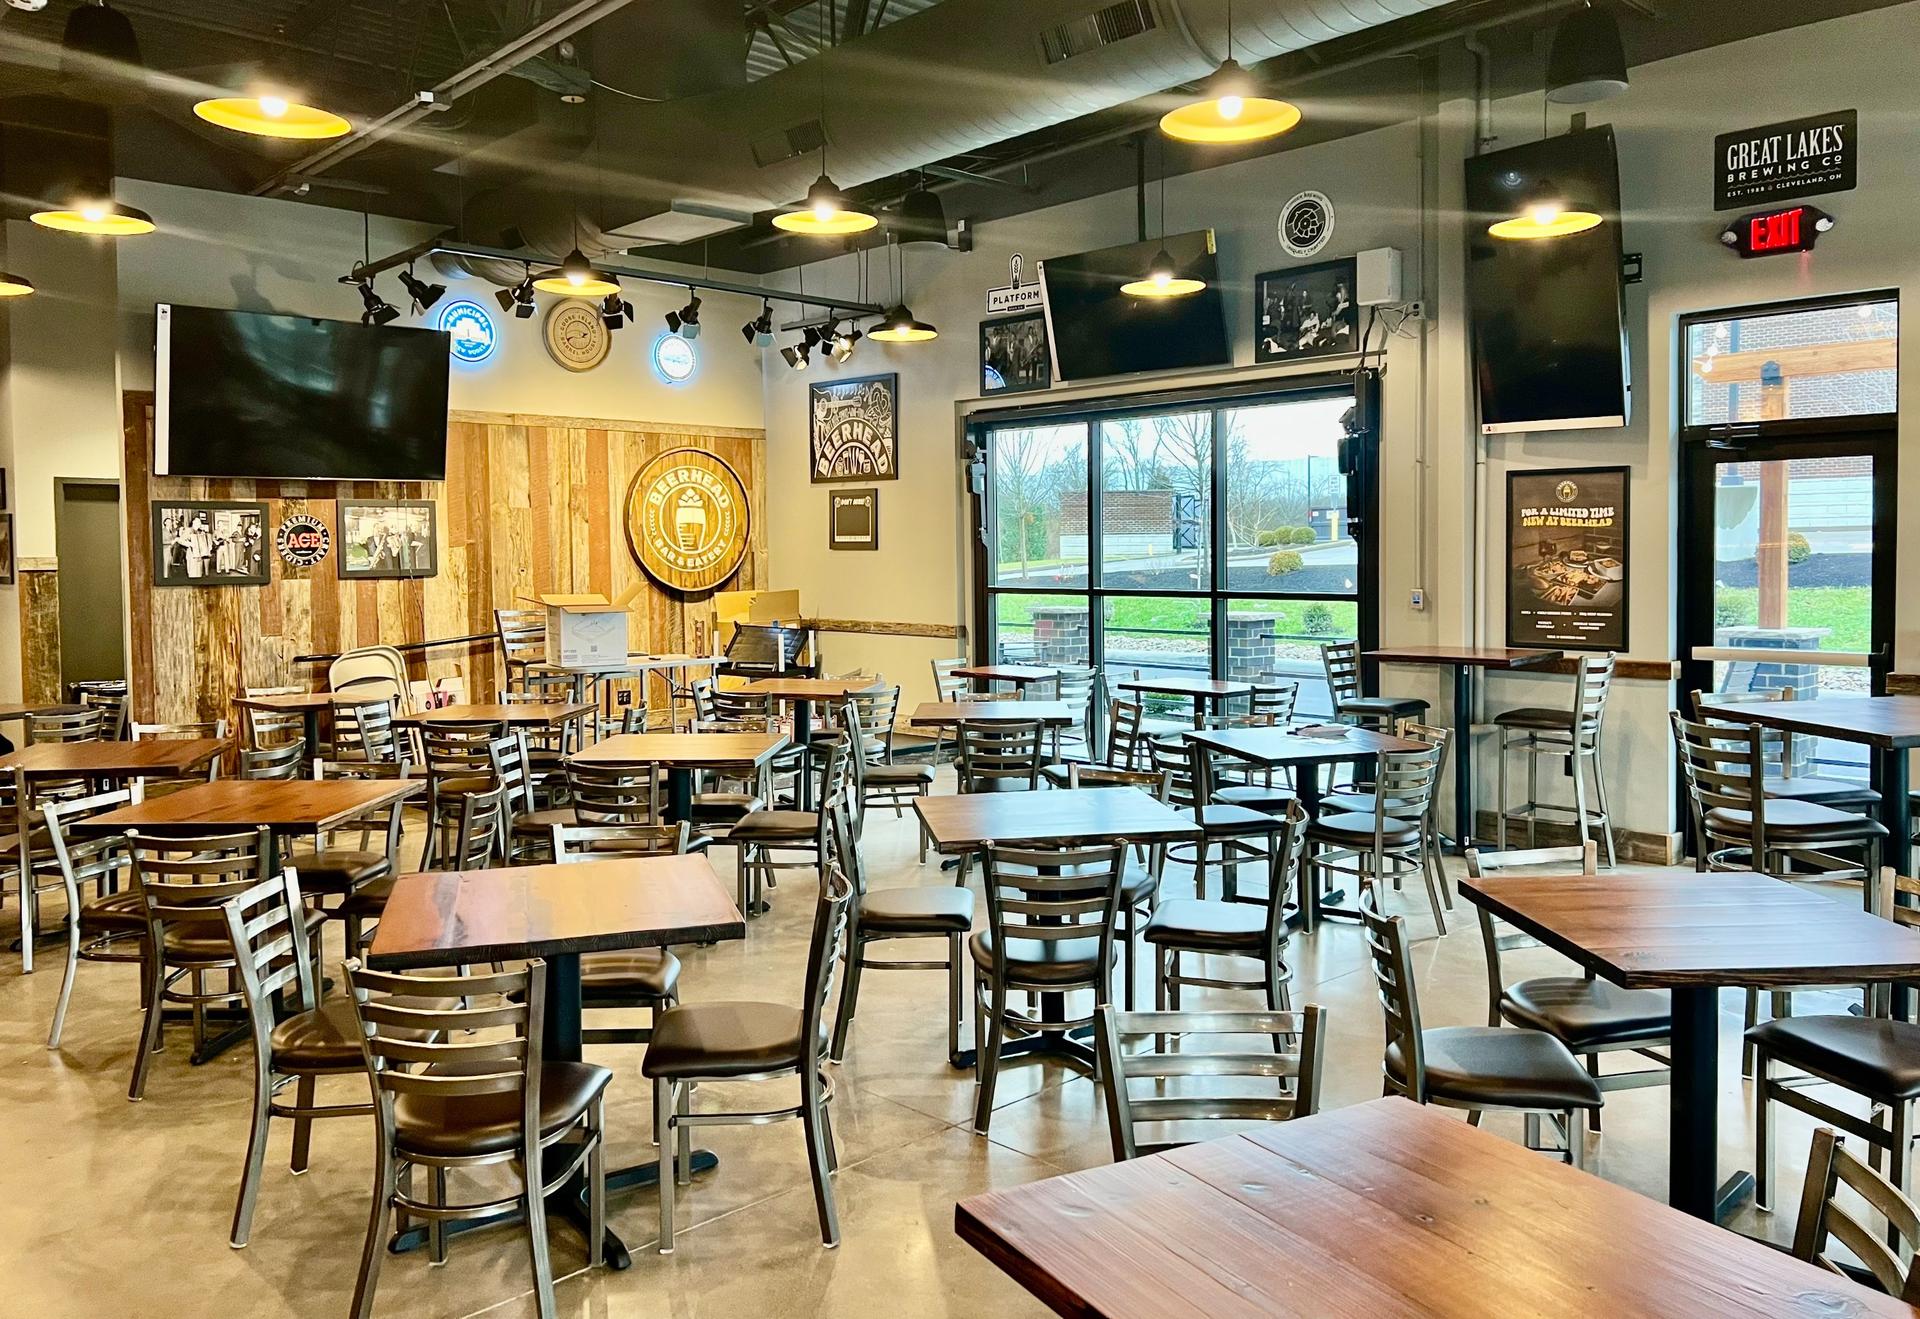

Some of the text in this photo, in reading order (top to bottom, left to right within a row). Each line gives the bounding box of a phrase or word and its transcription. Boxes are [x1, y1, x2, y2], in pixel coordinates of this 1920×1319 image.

[1727, 124, 1844, 171] GREAT LAKES
[1727, 160, 1810, 183] BREWING
[1747, 186, 1765, 194] 1988
[1829, 173, 1842, 181] OH
[1751, 208, 1803, 250] EXIT
[993, 290, 1039, 305] PLATFORM
[447, 307, 489, 328] MUNICIPAL
[578, 314, 597, 334] ISLAND
[560, 337, 597, 355] BARREL HOUSE
[818, 421, 888, 476] BEERHEAD
[648, 469, 730, 508] BEERHEAD
[1521, 506, 1615, 518] FOR A LIMITED TIME
[1522, 516, 1613, 527] NEW AT BEERHEAD
[277, 515, 330, 566] PREMIUM CRAFT CIDERS
[287, 532, 321, 549] ACE
[654, 538, 727, 567] BAR & EATERY
